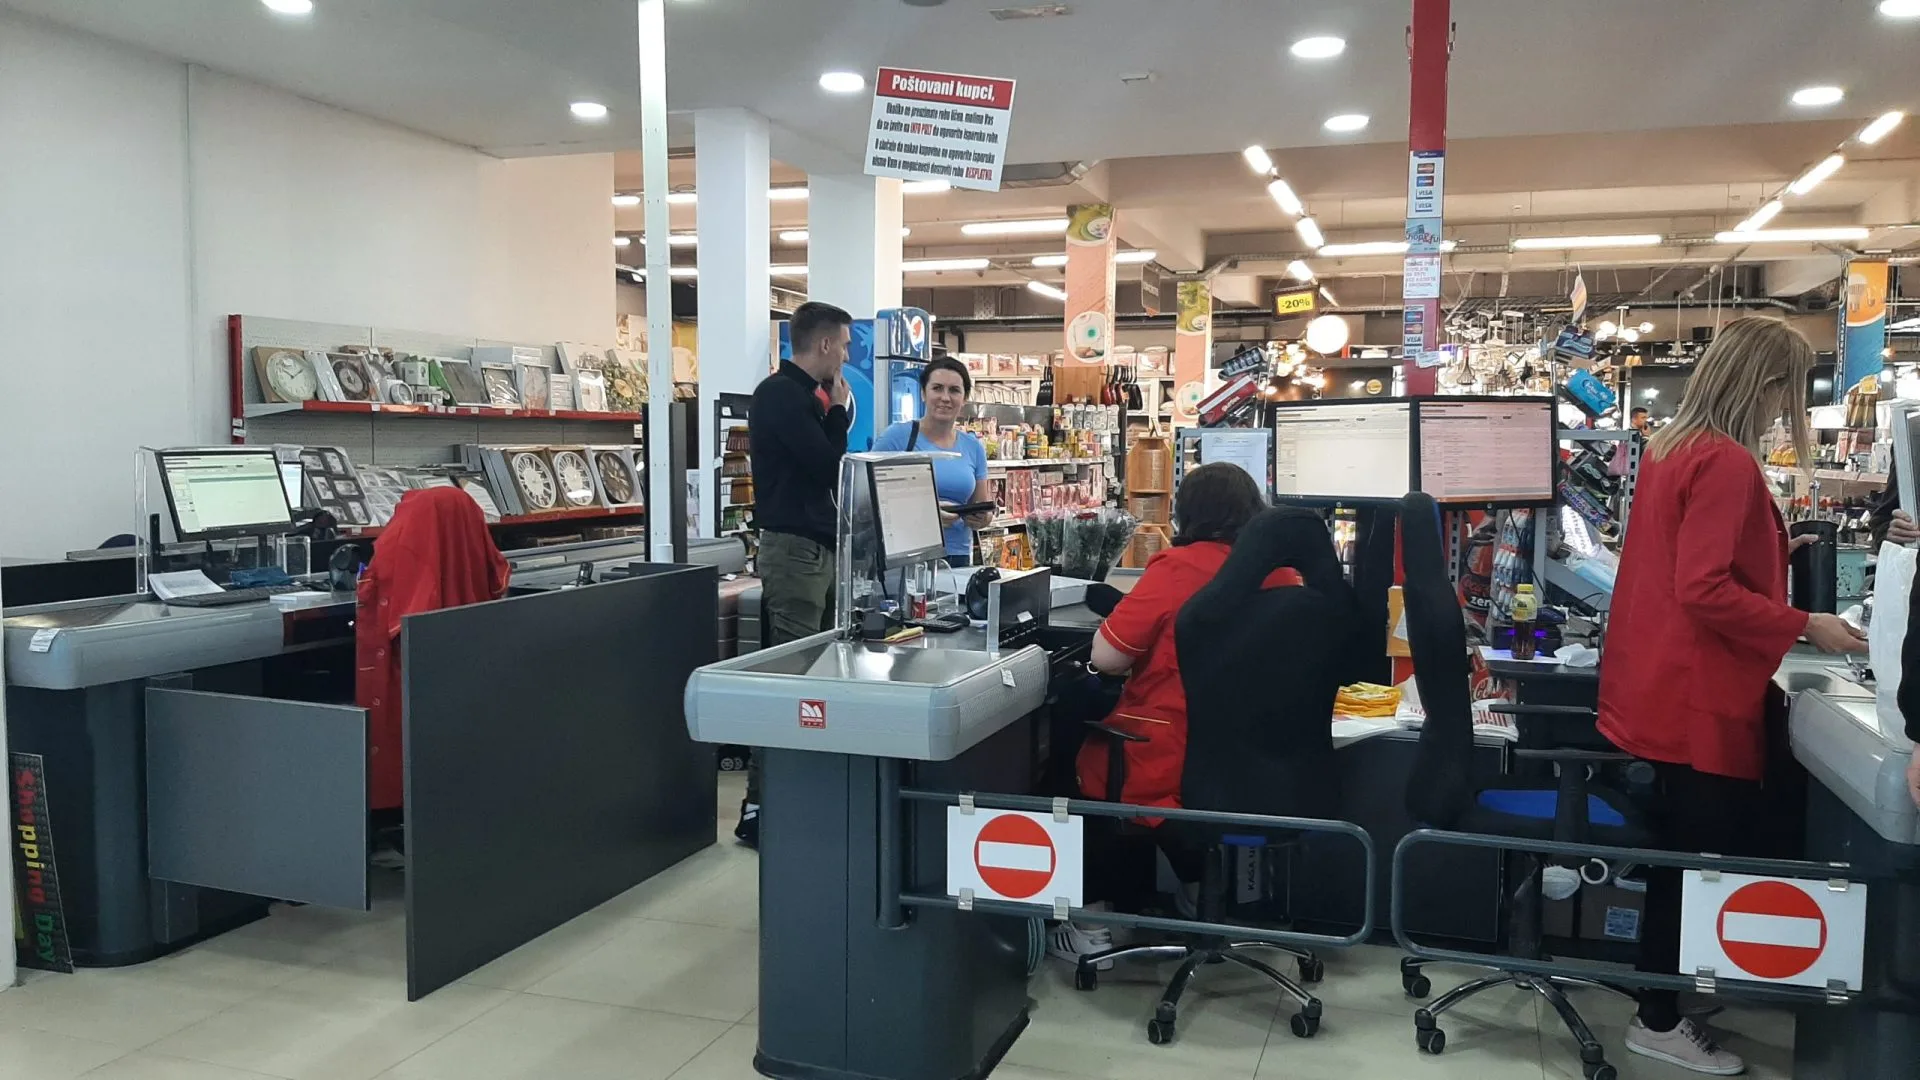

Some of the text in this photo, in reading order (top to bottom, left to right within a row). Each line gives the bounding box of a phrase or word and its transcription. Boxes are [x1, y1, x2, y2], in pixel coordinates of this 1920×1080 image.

[892, 75, 995, 102] Poštovani kupci,
[1282, 297, 1310, 309] -20%
